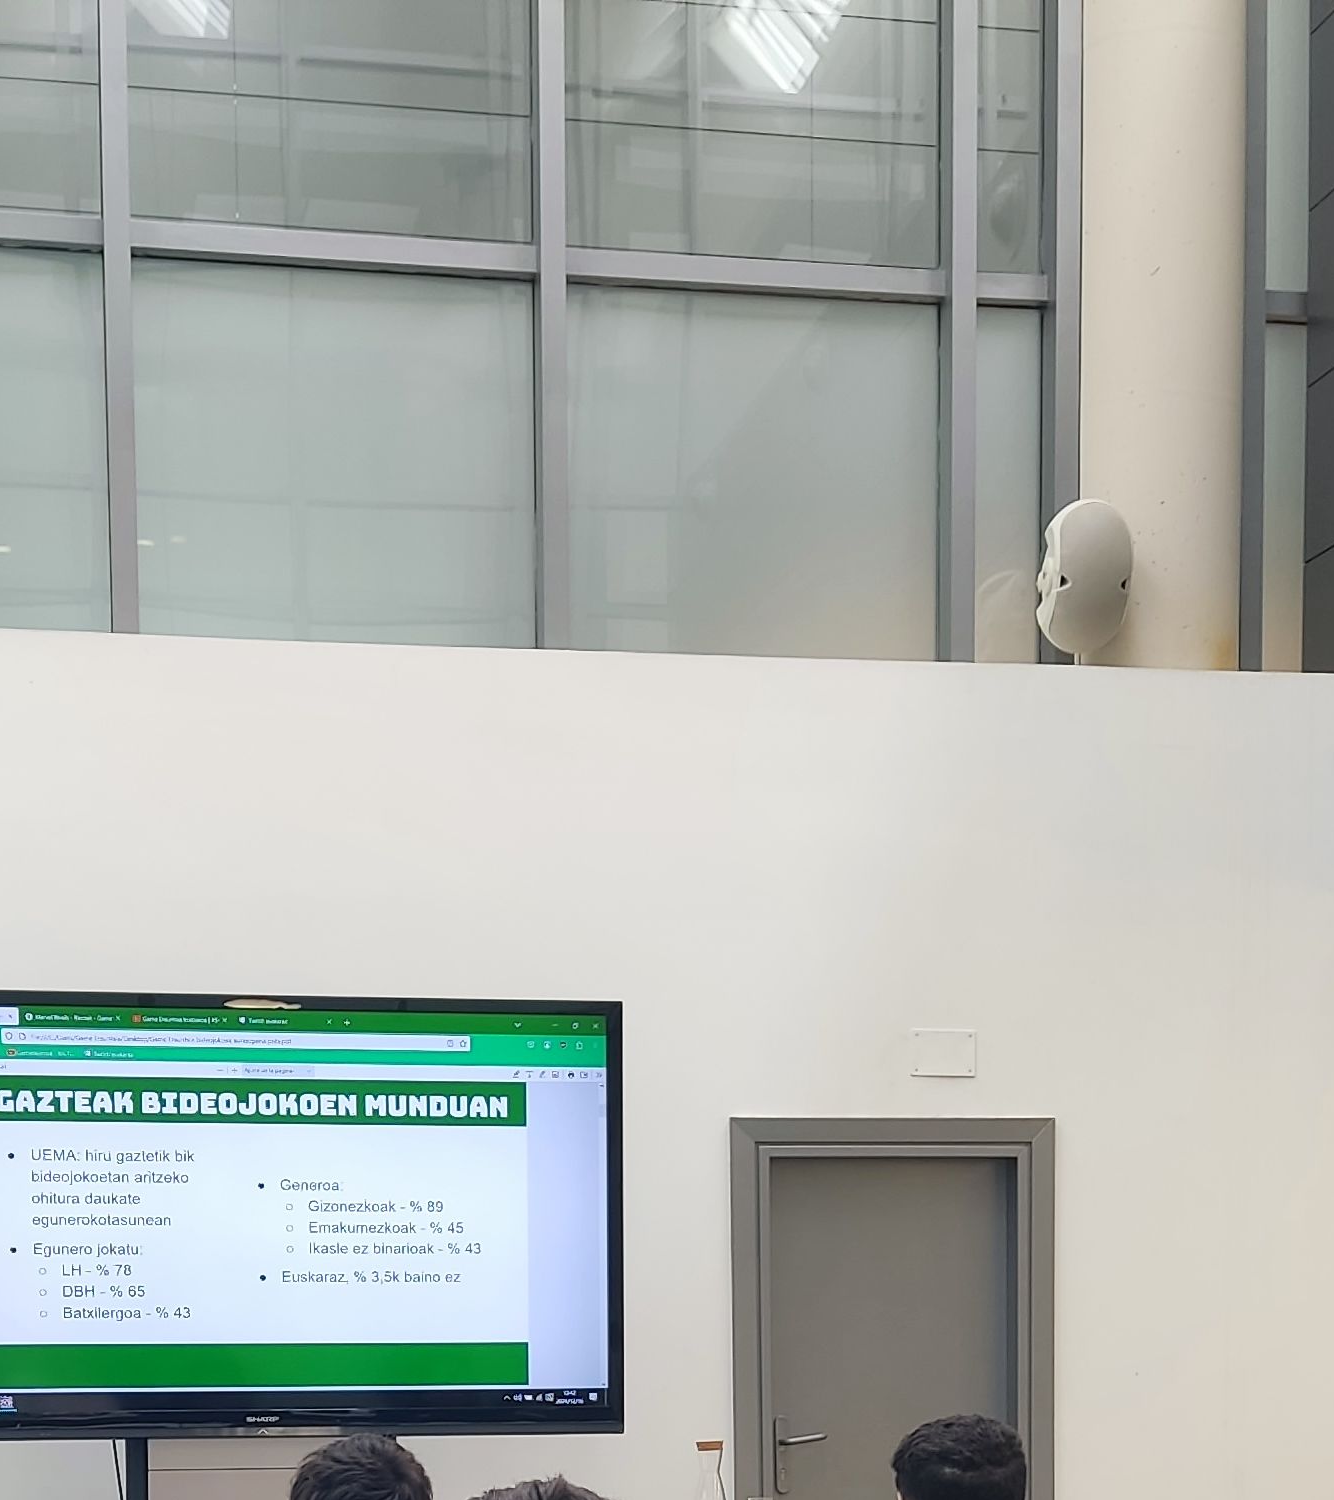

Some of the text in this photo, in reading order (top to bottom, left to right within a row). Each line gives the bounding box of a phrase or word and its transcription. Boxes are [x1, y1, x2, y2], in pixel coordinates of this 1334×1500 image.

[141, 1091, 358, 1116] BIDEOJOKOEN
[365, 1094, 508, 1118] MUNDUAN
[31, 1149, 195, 1165] UEMA: hiru gaztetik bik
[31, 1169, 189, 1185] bideojokoetan aritzeko
[32, 1192, 141, 1205] ohitura daukate
[308, 1199, 396, 1213] Gizonezkoak
[409, 1201, 423, 1212] %
[427, 1200, 444, 1212] 89
[32, 1213, 172, 1229] egunerokotasunean
[308, 1221, 417, 1234] Emakumezkoak
[429, 1222, 443, 1234] %
[447, 1222, 464, 1234] 45
[33, 1243, 93, 1257] Egunero
[309, 1242, 349, 1255] Ikasle
[352, 1245, 368, 1255] ez
[373, 1242, 435, 1255] binarioak
[447, 1243, 460, 1254] %
[465, 1243, 482, 1254] 43
[62, 1264, 82, 1276] LH
[96, 1264, 110, 1276] %
[114, 1264, 132, 1276] 78
[353, 1271, 367, 1283] %
[371, 1270, 400, 1285] 3,5k
[404, 1270, 441, 1283] baino
[445, 1274, 462, 1283] ez
[62, 1285, 95, 1298] DBH
[110, 1285, 123, 1297] %
[128, 1285, 146, 1297] 65
[63, 1307, 141, 1321] Batxilergoa
[155, 1307, 169, 1319] %
[173, 1307, 191, 1319] 43
[246, 1415, 280, 1423] SHARP
